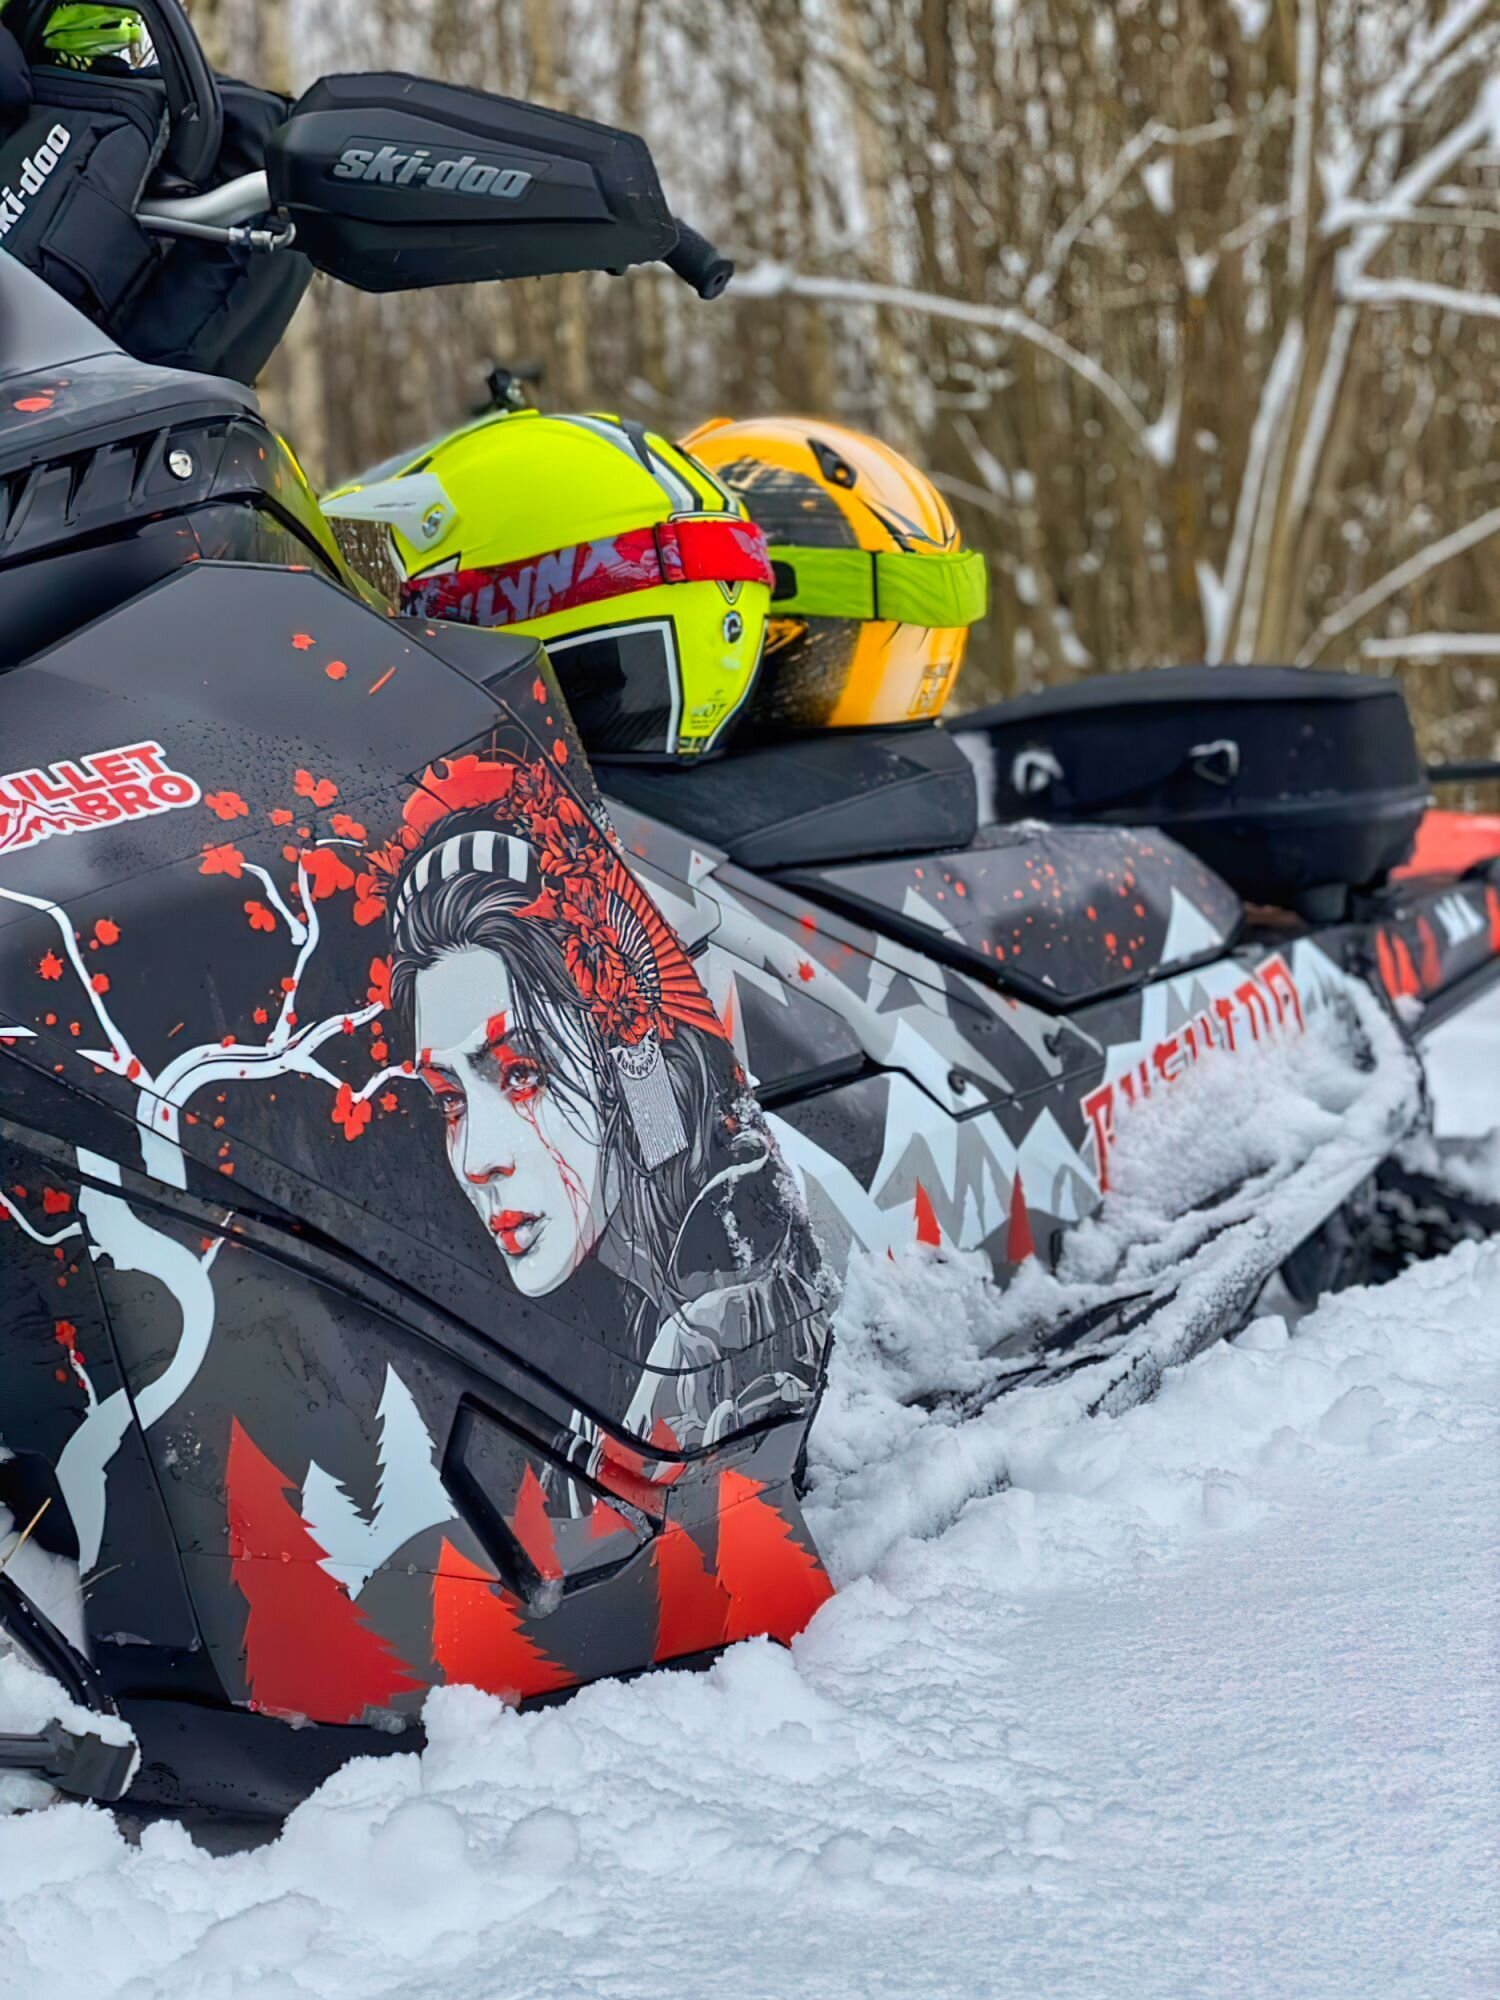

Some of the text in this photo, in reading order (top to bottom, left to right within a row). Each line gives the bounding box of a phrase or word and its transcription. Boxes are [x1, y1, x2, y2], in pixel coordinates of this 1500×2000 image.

[0, 123, 71, 240] ki-doo
[333, 146, 533, 198] ski-doo
[70, 774, 194, 821] BRO
